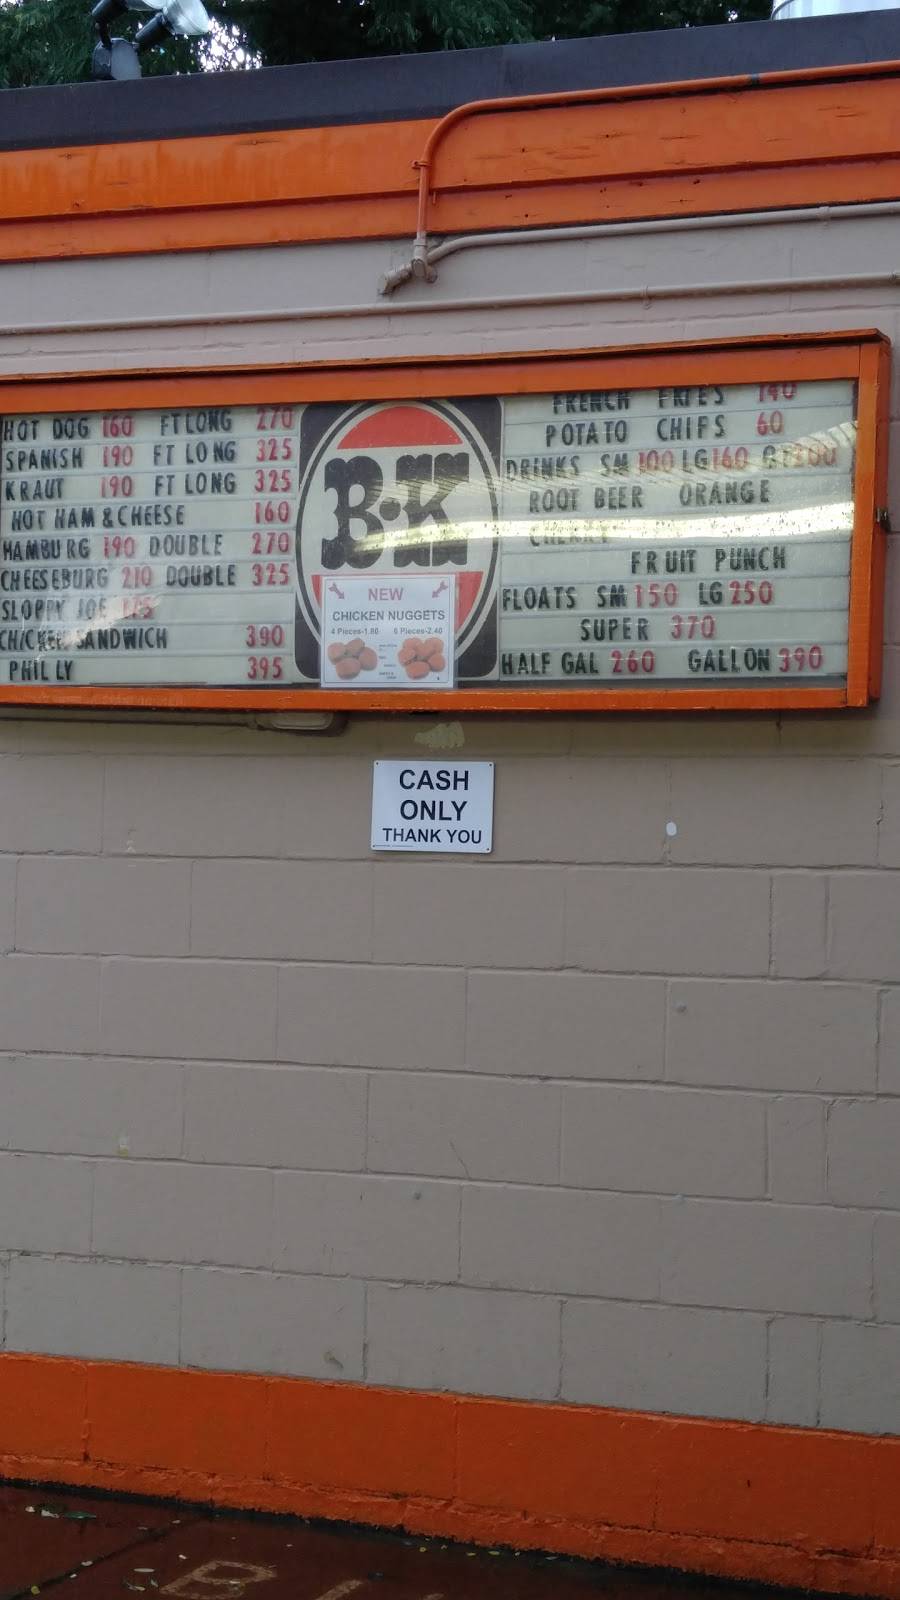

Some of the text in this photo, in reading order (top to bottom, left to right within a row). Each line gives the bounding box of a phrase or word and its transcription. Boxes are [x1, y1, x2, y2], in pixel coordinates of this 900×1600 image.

[4, 420, 39, 440] HOT
[53, 418, 89, 439] DOG
[102, 416, 133, 437] 160
[256, 405, 293, 430] 270
[546, 420, 628, 447] POTATO
[757, 411, 784, 436] 60
[6, 438, 291, 471] SPANISH 190 FT LONG 325
[506, 455, 580, 481] DRINKS
[712, 447, 749, 472] 160
[6, 469, 290, 500] KRAUT 190 FT LONG 325
[529, 480, 771, 513] ROOT BEER ORANGE
[12, 510, 45, 531] HOT
[255, 501, 289, 523] 160
[2, 532, 289, 560] HAMBURG 190 DOUBLE 270
[631, 546, 786, 574] FRUIT PUNCH
[1, 563, 289, 591] CHEESEBURG 210 DOUBLE 325
[368, 588, 404, 601] NEW
[502, 580, 773, 610] FLOATS SM 150 LG 250
[2, 599, 64, 620] SLOPPY
[77, 598, 106, 620] JOE
[332, 609, 445, 621] CHICKEN NUGGETS
[77, 628, 167, 650] SANDWICH
[246, 625, 284, 648] 390
[580, 614, 716, 641] SUPER 370
[9, 656, 282, 681] PHILLY 395
[501, 644, 823, 675] HALF GAL 260 GALLON 390
[399, 769, 469, 791] CASH
[400, 799, 468, 822] ONLY
[382, 828, 482, 844] THANK YOU
